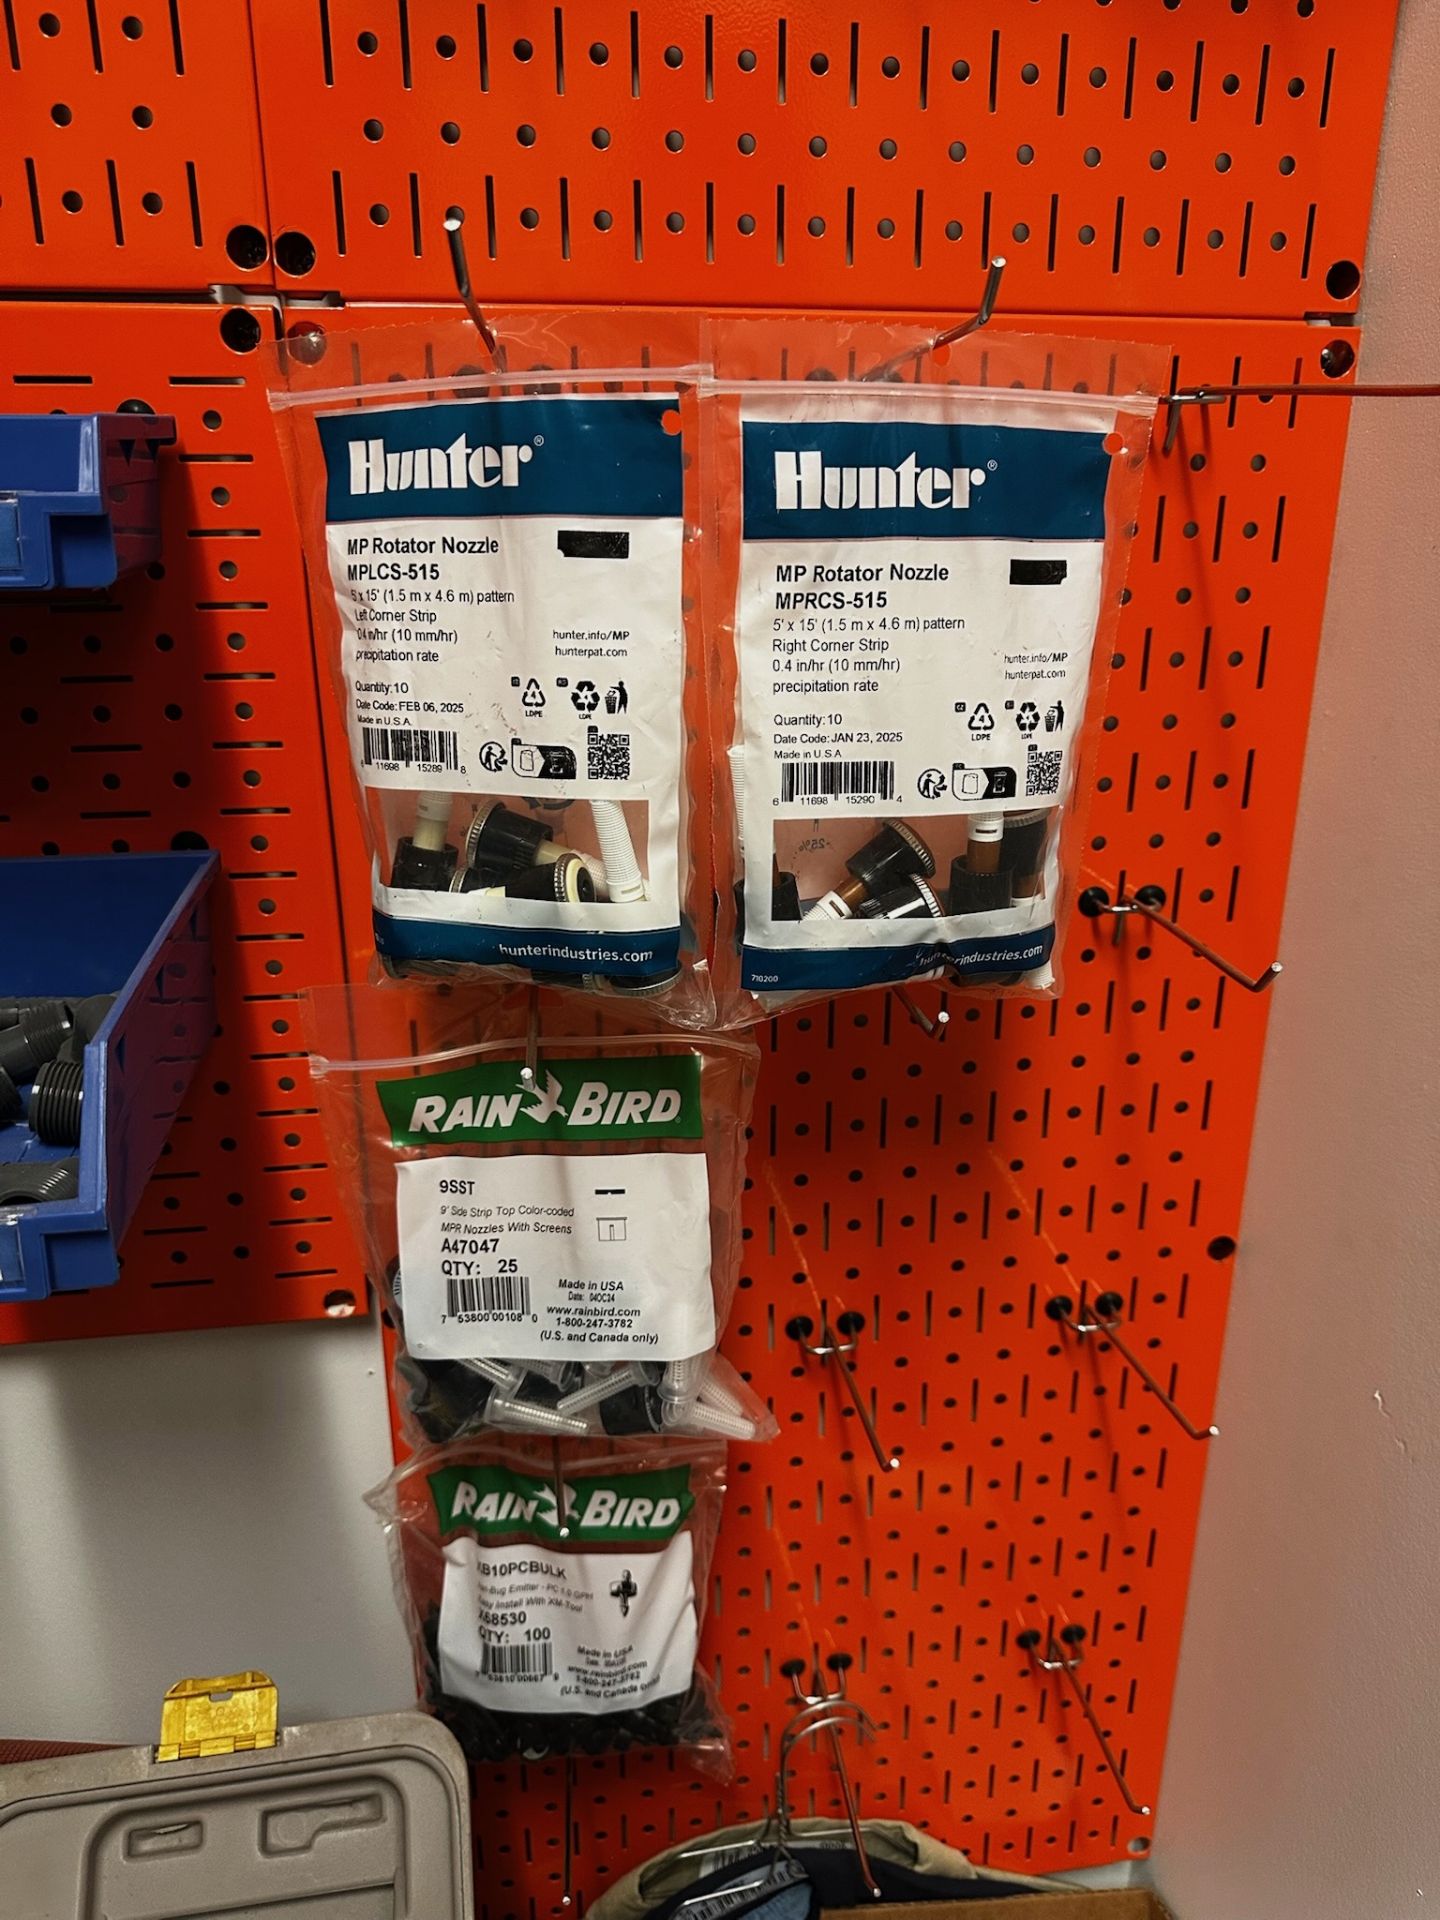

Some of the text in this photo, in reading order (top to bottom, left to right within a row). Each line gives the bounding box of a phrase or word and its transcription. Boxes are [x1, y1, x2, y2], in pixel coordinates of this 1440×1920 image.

[348, 432, 533, 495] Hunter
[774, 451, 986, 510] Hunter
[347, 536, 499, 555] MP Rotator Nozzle
[347, 563, 440, 581] MPLCS-515
[776, 563, 949, 582] MP Rotator Nozzle
[383, 588, 406, 605] (1.5
[410, 591, 421, 602] m
[425, 591, 431, 602] x
[435, 589, 455, 602] 4.6
[459, 589, 474, 605] m)
[476, 590, 515, 605] pattern
[775, 591, 888, 610] MPRCS-515
[369, 608, 405, 622] Corner
[409, 608, 437, 624] Strip
[773, 617, 965, 634] 5' x 15' (1.5 m x 4.6 m) pattern
[357, 627, 367, 640] 04
[391, 627, 412, 643] (10
[415, 629, 458, 644] mm/hr)
[552, 629, 630, 641] hunter.info/MP
[555, 646, 628, 659] hunterpat.com
[773, 638, 889, 654] Right Corner Strip
[416, 650, 439, 662] rate
[1004, 652, 1069, 664] hunter.info/MP
[772, 657, 901, 674] 0.4 in/hr (10 mm/hr)
[1004, 669, 1066, 680] hunterpat.com
[356, 680, 409, 695] Quantity: 10
[773, 679, 879, 695] precipitation rate
[372, 700, 397, 711] Code:
[399, 701, 420, 711] FEB
[423, 702, 438, 714] 06,
[440, 703, 464, 713] 2025
[525, 710, 543, 718] LDPE
[774, 713, 843, 728] Quantity: 10
[773, 732, 903, 744] Date Code: JAN 23, 2025
[971, 733, 991, 741] LDPE
[774, 750, 801, 759] Made
[803, 750, 811, 758] in
[460, 766, 467, 775] 8
[772, 795, 903, 806] 6 11698 15290 4
[499, 943, 653, 962] hunterindustries.com
[408, 1082, 681, 1133] RAIN BIRD
[439, 1180, 475, 1195] 9SST
[470, 1207, 493, 1218] Strip
[496, 1206, 516, 1217] Top
[518, 1205, 575, 1217] Color-coded
[441, 1222, 572, 1234] MPR Nozzles With Screens
[441, 1238, 500, 1254] A47047
[441, 1259, 518, 1276] QTY: 25
[558, 1279, 624, 1291] Made in USA
[441, 1314, 447, 1324] 7
[492, 1312, 523, 1322] 00108
[531, 1313, 538, 1323] 0
[546, 1305, 641, 1317] www.rainbird.com
[556, 1317, 633, 1329] 1-800-247-3782
[540, 1330, 659, 1345] (U.S. and Canada only)
[451, 1481, 681, 1527] RAIN BIRD
[479, 1625, 551, 1643] QTY: 100
